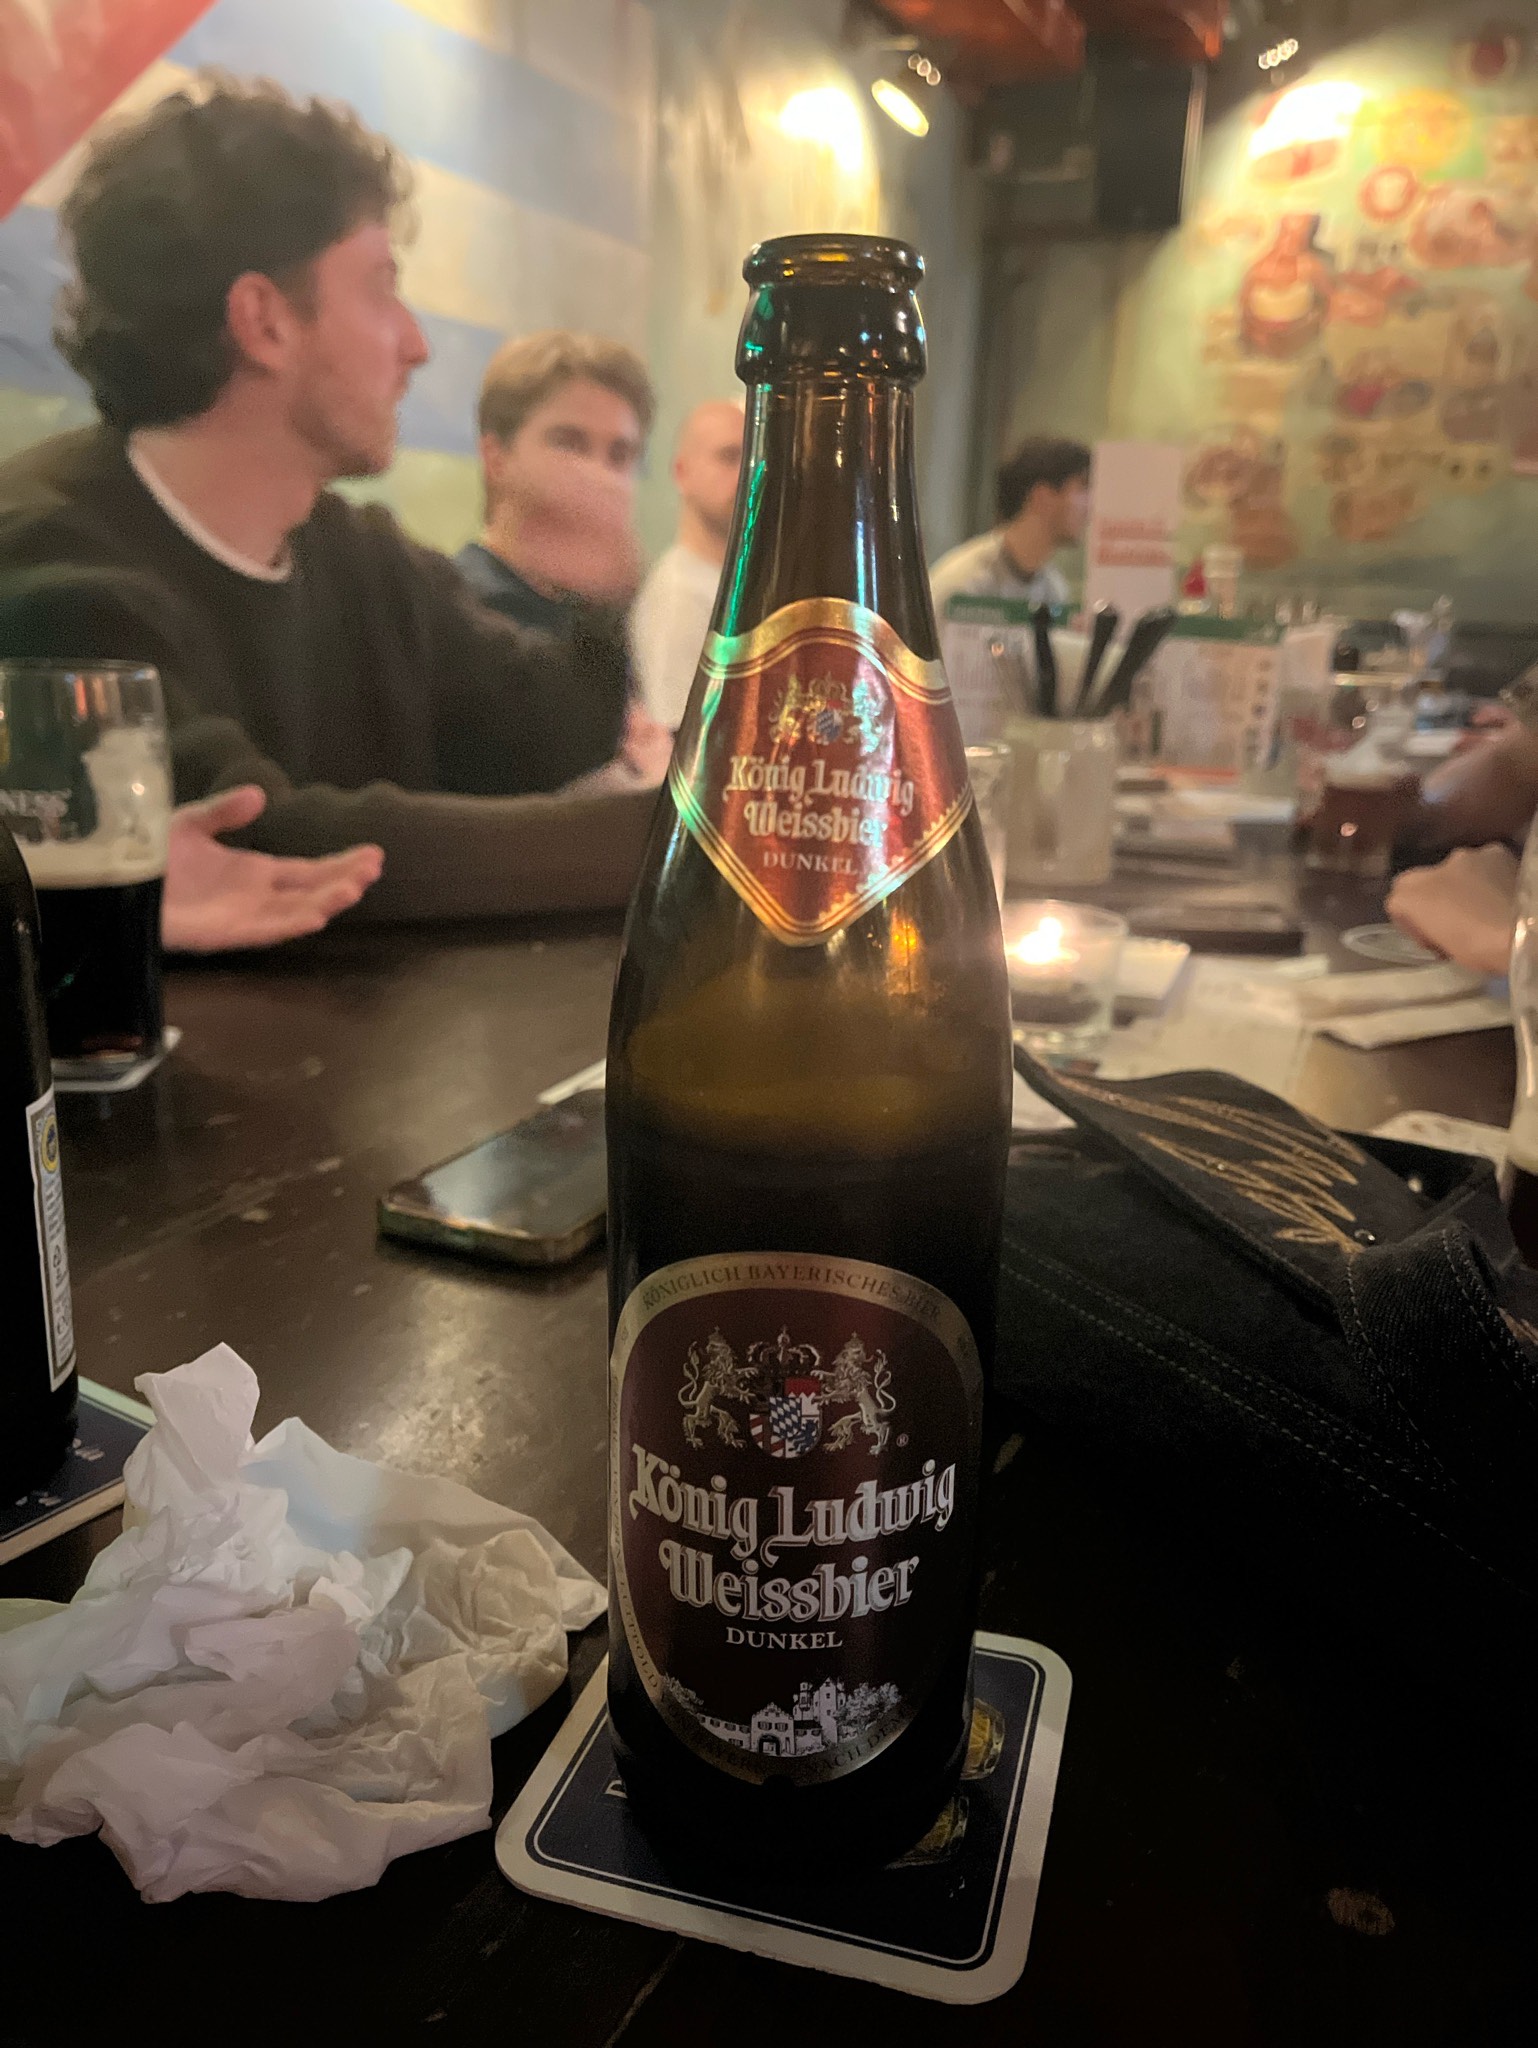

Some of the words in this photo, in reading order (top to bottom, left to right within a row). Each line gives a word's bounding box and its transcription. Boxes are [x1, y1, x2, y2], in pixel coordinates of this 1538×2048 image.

[722, 753, 806, 802] König
[803, 758, 914, 816] Ludwig
[743, 799, 887, 848] Weissbier
[763, 851, 857, 875] DUNKEL
[749, 1264, 901, 1300] BAYERISCHES
[629, 1443, 759, 1560] König
[761, 1459, 956, 1567] Ludwig
[659, 1539, 920, 1622] Weissbier
[726, 1626, 843, 1651] DUNKEL
